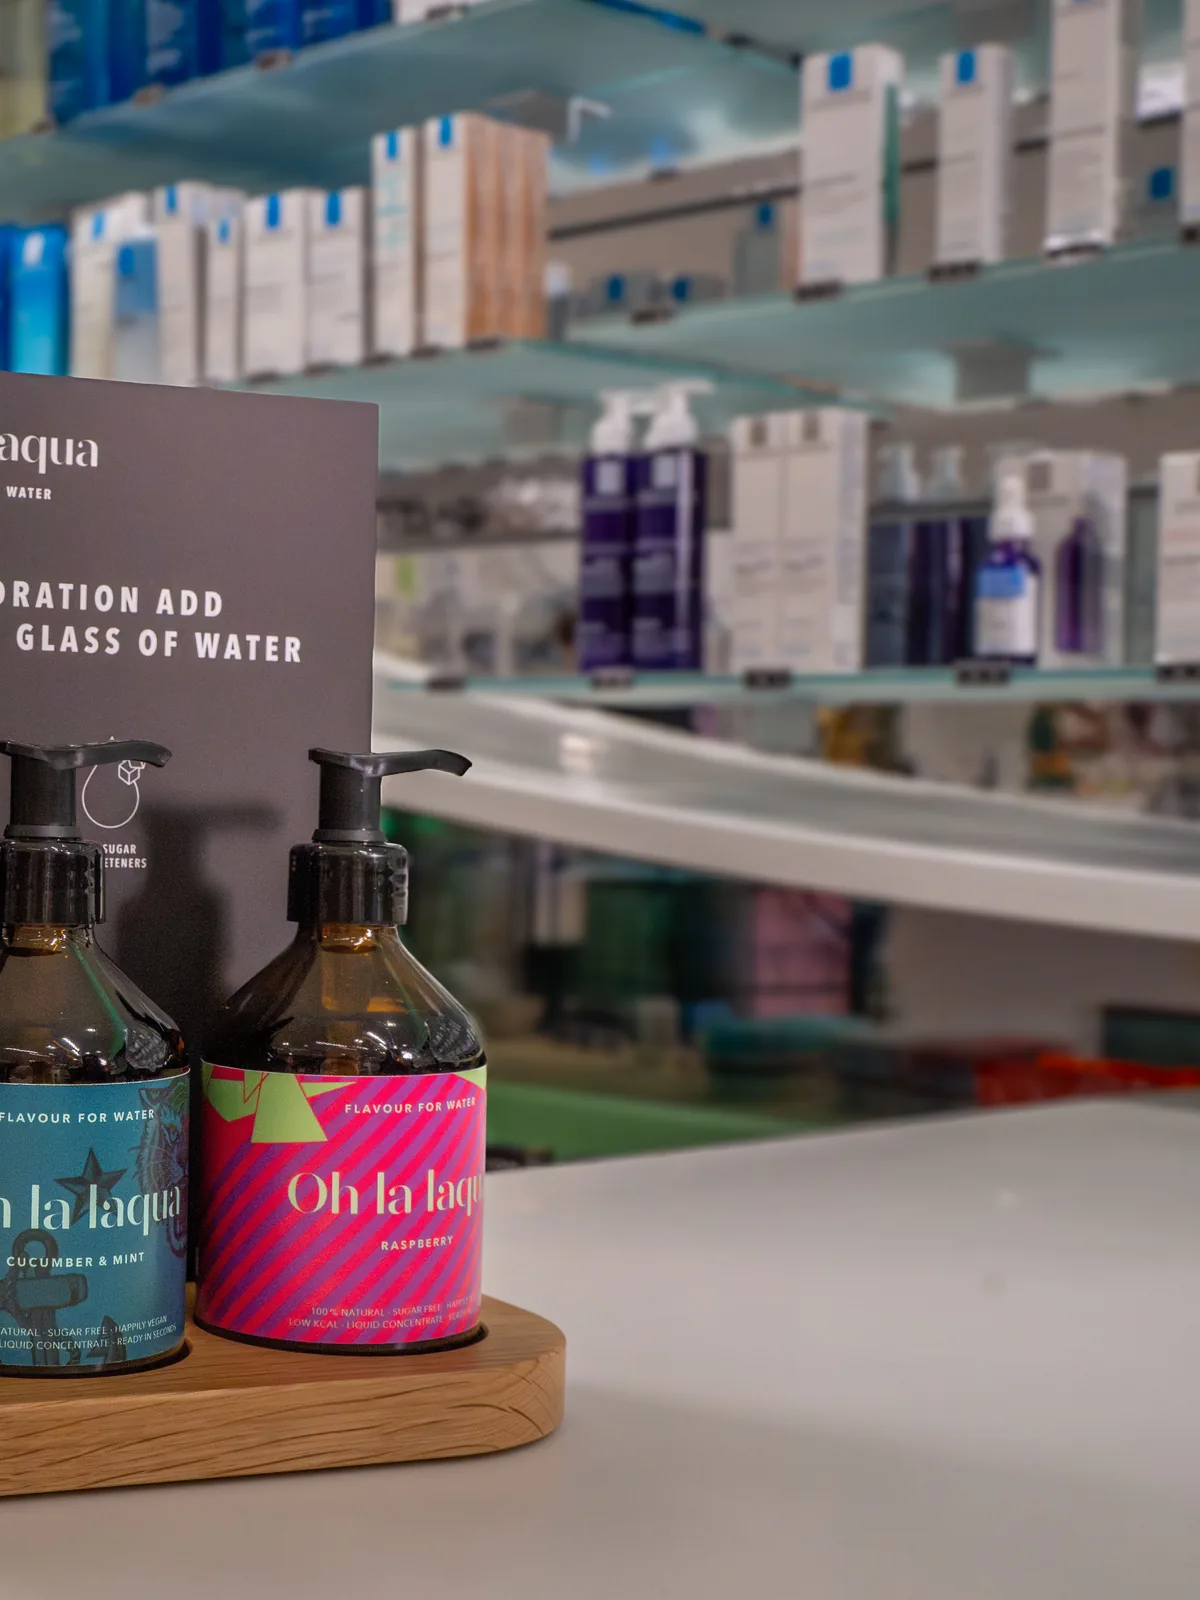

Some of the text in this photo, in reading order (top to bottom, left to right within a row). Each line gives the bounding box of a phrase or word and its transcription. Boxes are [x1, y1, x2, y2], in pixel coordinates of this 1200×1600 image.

[6, 486, 52, 500] WATER
[156, 588, 222, 617] ADD
[16, 623, 120, 655] GLASS
[138, 629, 178, 657] OF
[194, 632, 301, 663] WATER
[102, 844, 137, 854] SUGAR
[104, 858, 148, 868] ETENERS
[344, 1096, 476, 1114] FLAVOUR FOR WATER
[78, 1112, 107, 1123] FOR
[114, 1108, 155, 1122] WATER
[288, 1171, 358, 1214] Oh
[376, 1171, 412, 1215] la
[30, 1184, 70, 1230] la
[89, 1184, 180, 1237] laqua
[380, 1235, 453, 1251] RASPBERRY
[6, 1252, 146, 1268] CUCUMBER & MINT
[340, 1308, 384, 1317] NATURAL
[392, 1306, 422, 1316] SUGAR
[48, 1328, 82, 1337] SUGAR
[114, 1320, 146, 1333] HAPPILY
[147, 1314, 168, 1328] VEGAN
[288, 1318, 311, 1328] LOW
[313, 1320, 339, 1328] KCAL
[346, 1320, 380, 1329] LIQUID
[382, 1316, 442, 1329] CONCENTRATE
[36, 1338, 110, 1350] CONCENTRATE
[117, 1334, 144, 1346] READY
[144, 1332, 152, 1340] IN
